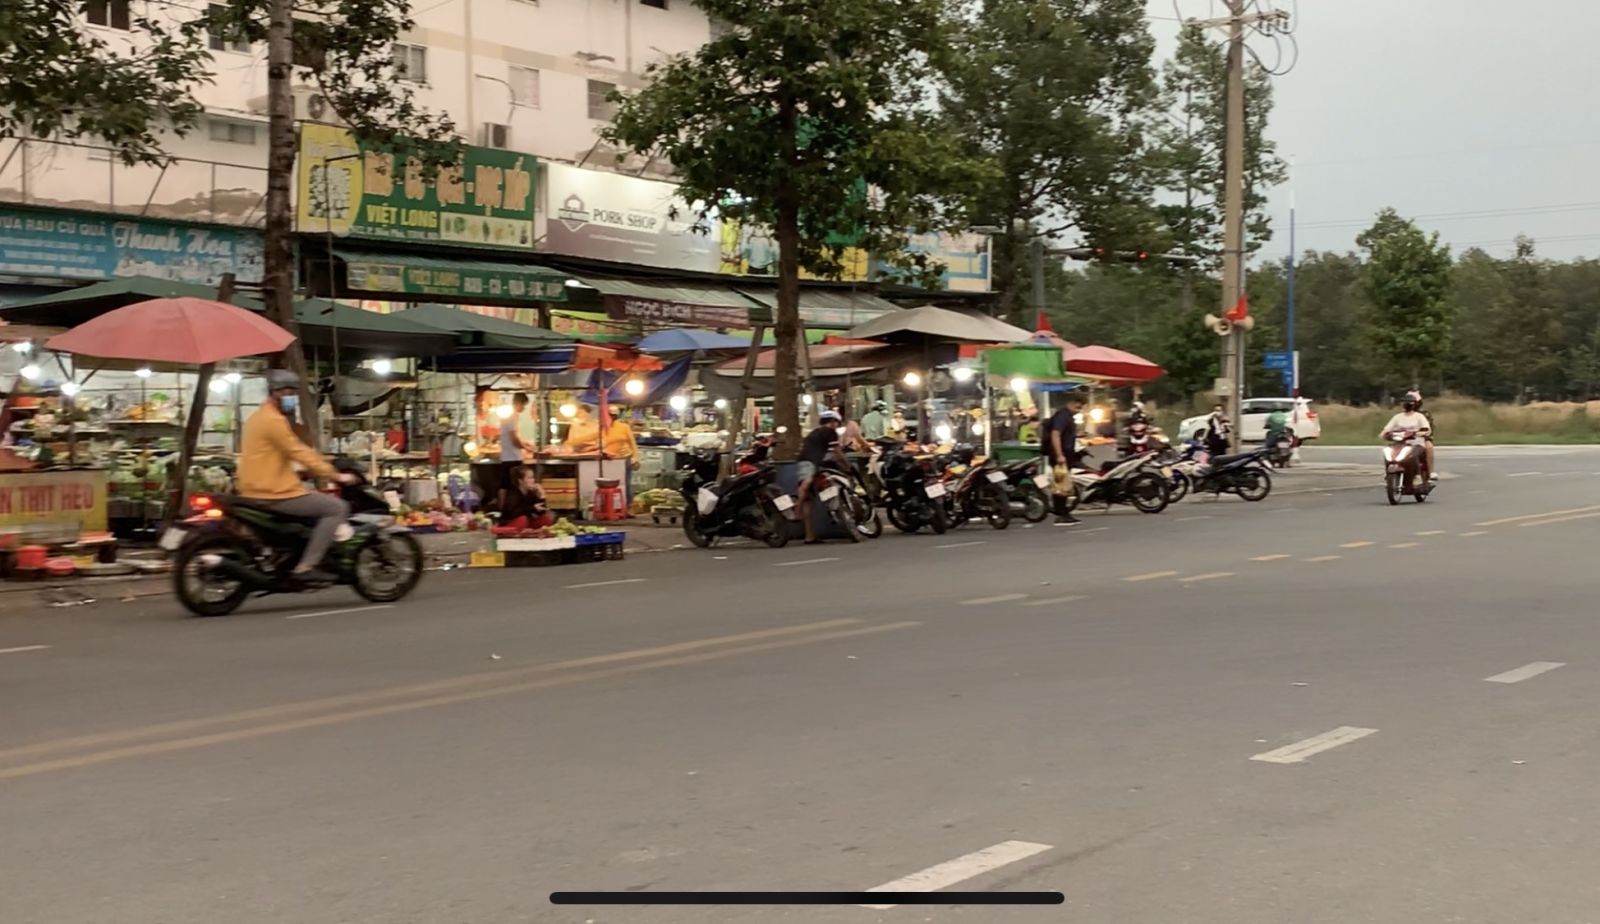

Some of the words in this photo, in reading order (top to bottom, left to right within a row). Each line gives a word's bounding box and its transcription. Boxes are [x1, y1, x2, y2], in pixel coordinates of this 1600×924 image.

[25, 218, 54, 232] RAU
[366, 203, 398, 227] VIỆT
[400, 208, 438, 228] LONG
[593, 208, 623, 225] PORK
[627, 214, 657, 229] SHOP
[112, 221, 182, 252] Thanh
